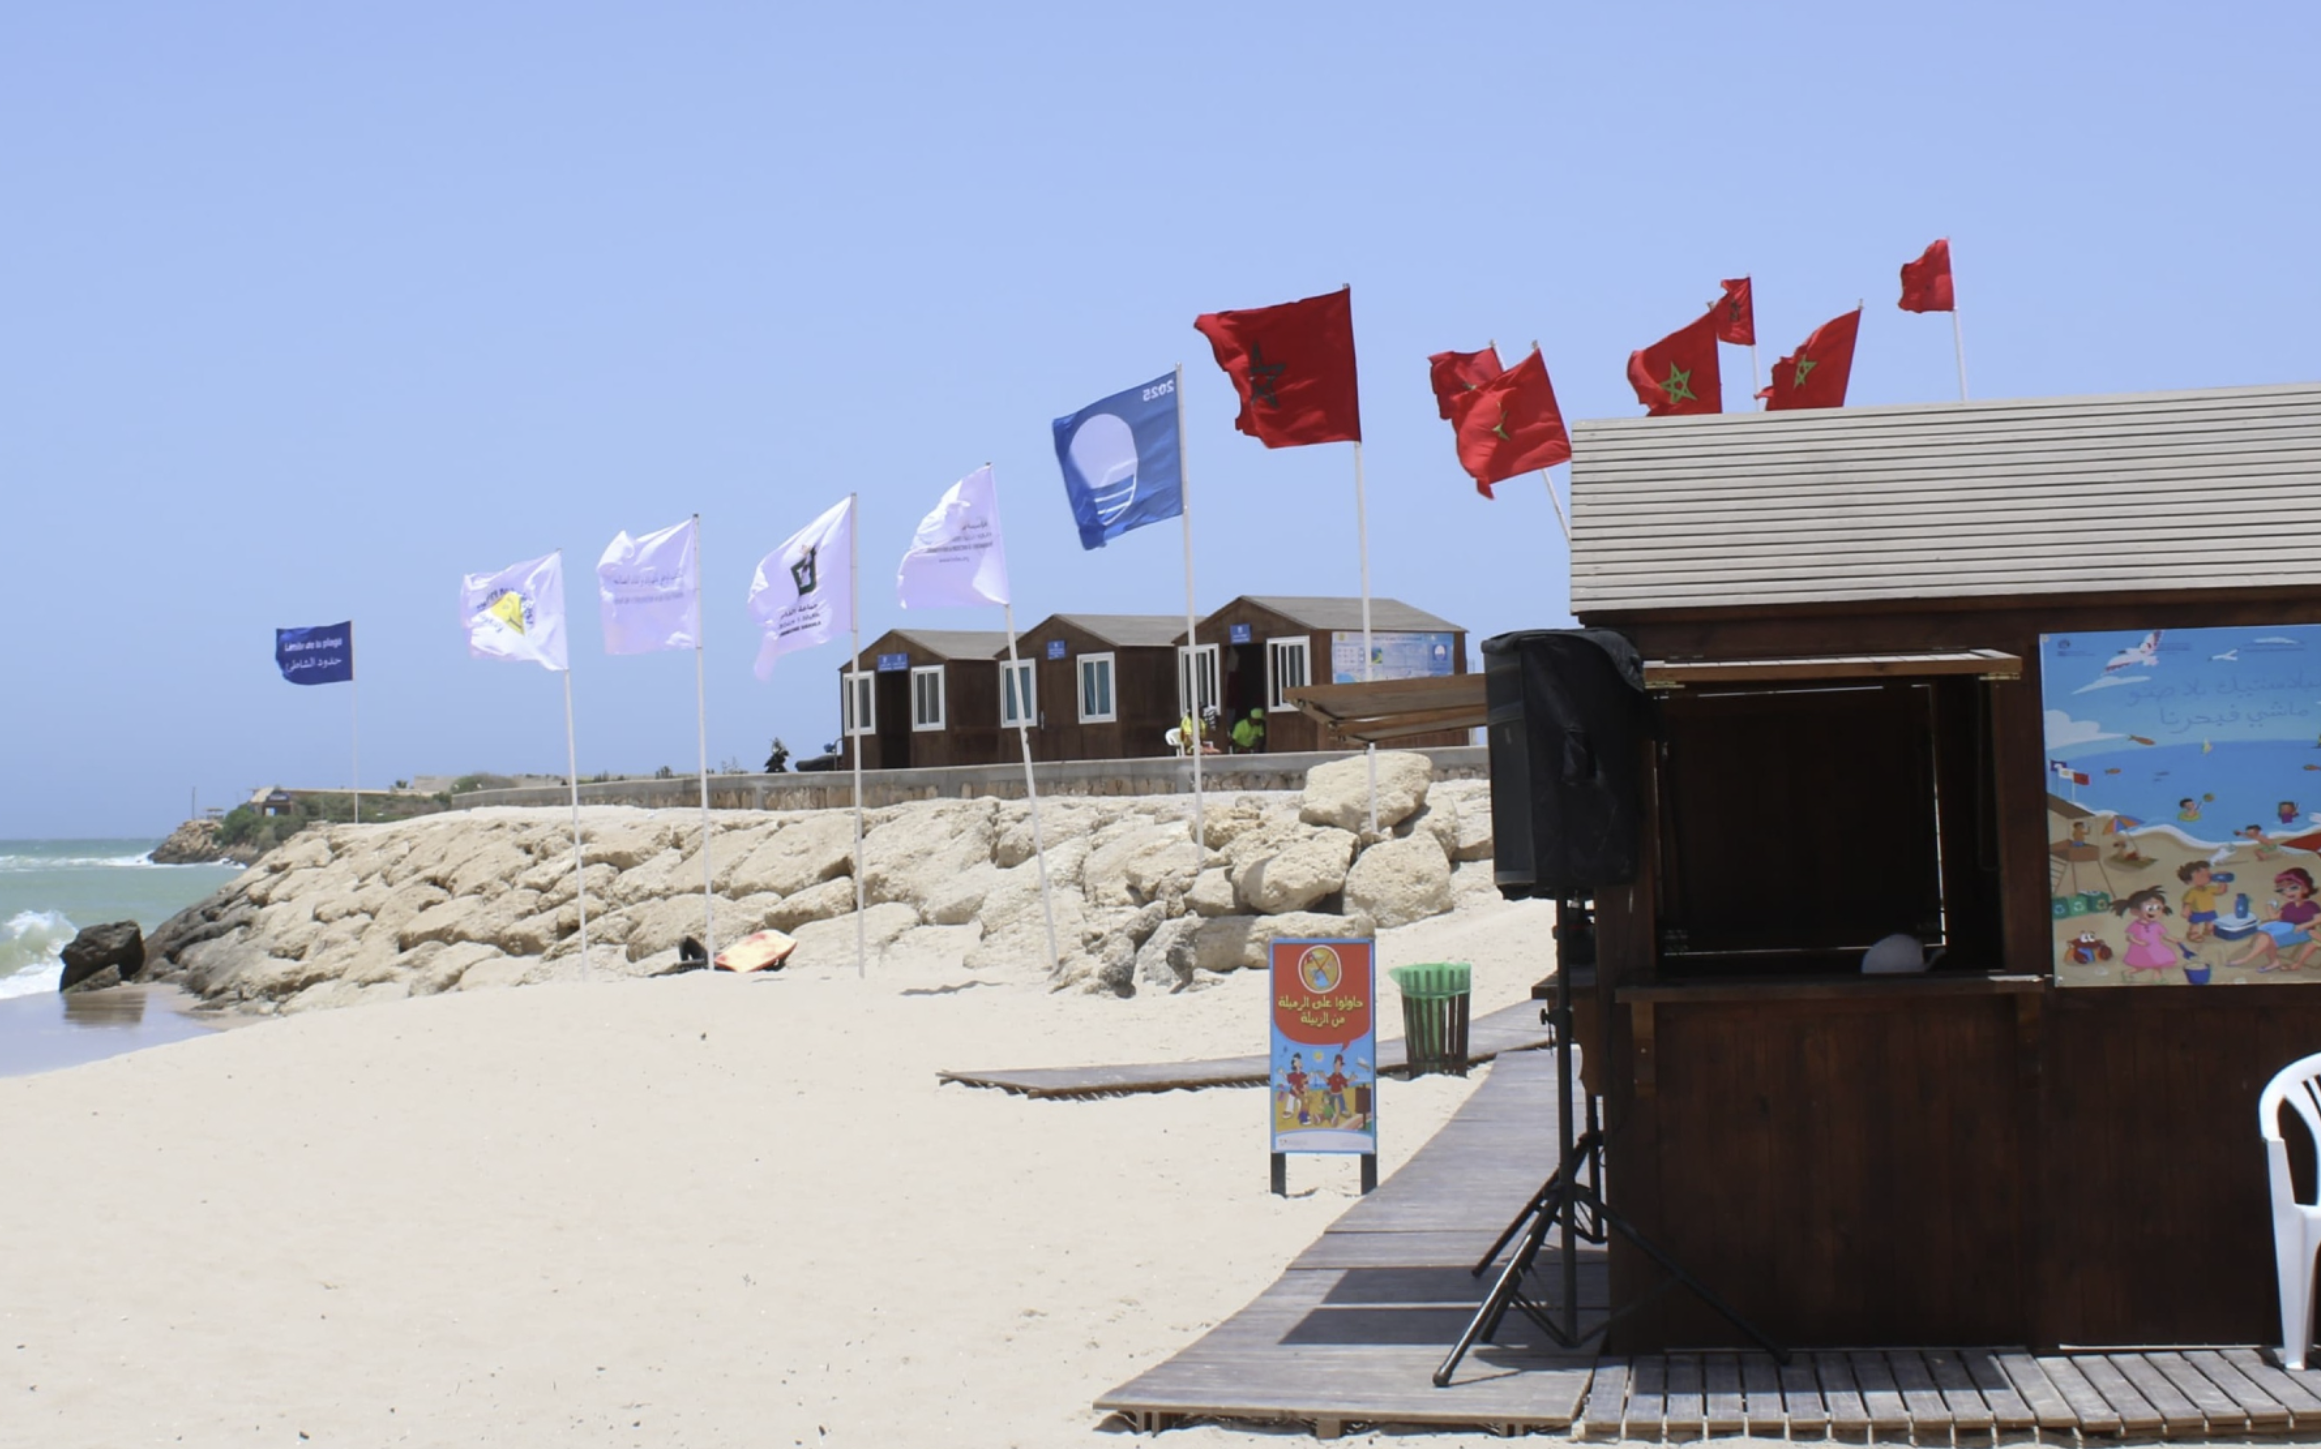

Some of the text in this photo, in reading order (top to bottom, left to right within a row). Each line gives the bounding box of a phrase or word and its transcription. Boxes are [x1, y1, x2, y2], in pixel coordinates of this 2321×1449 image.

[317, 656, 342, 669] حدود
[2246, 700, 2309, 728] ماشي
[1311, 994, 1333, 1010] على
[1334, 994, 1364, 1012] حاولوا
[1331, 1013, 1346, 1028] من
